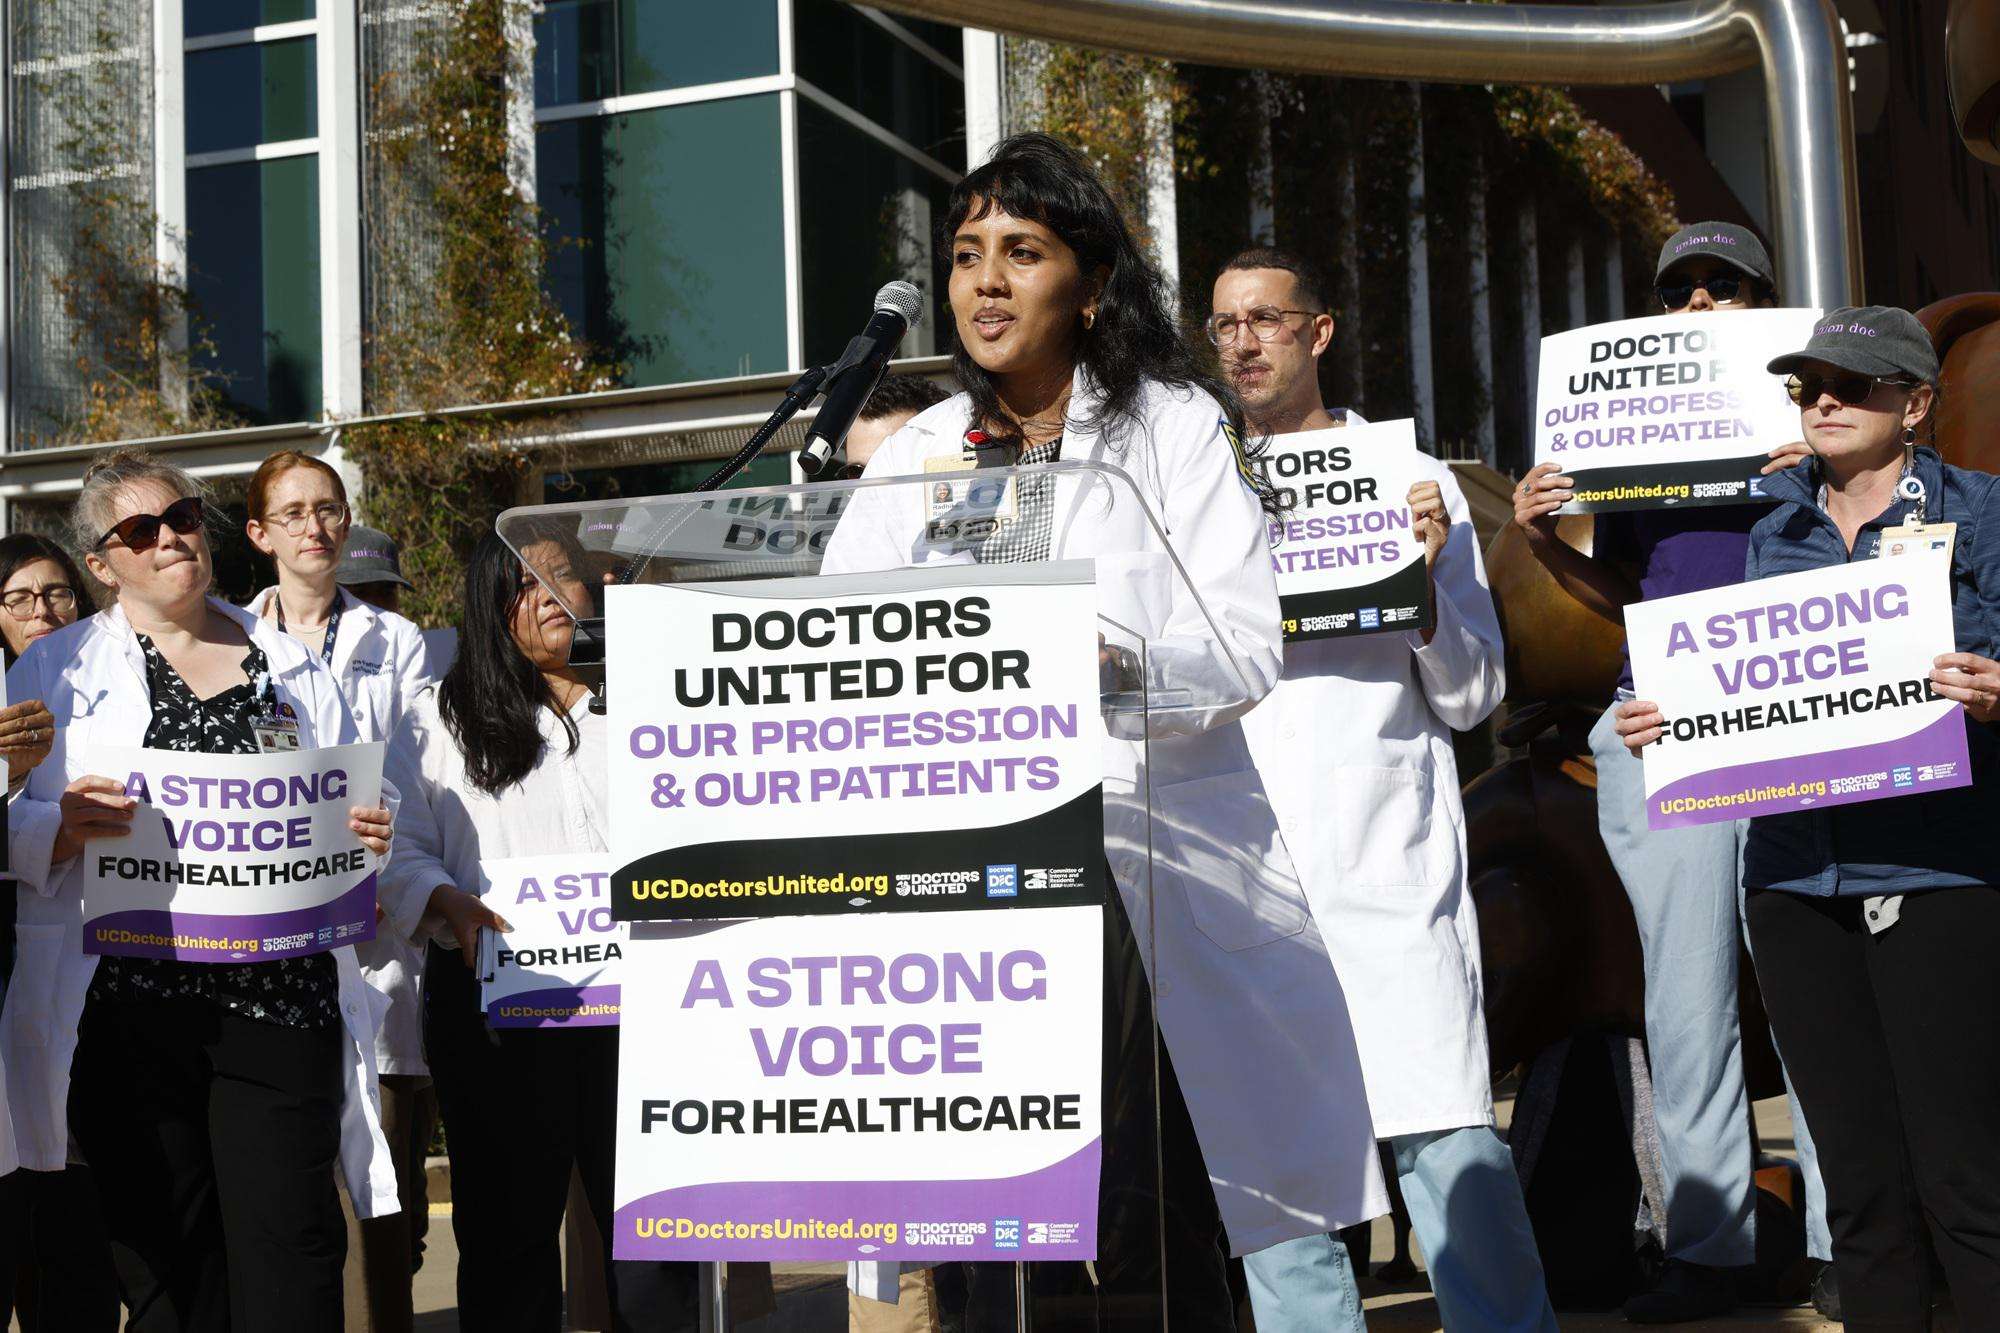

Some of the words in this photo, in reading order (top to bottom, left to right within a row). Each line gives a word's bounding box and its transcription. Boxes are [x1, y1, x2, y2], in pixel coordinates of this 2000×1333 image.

[1590, 330, 1710, 363] DOCTO
[1849, 322, 1877, 338] doc
[1569, 361, 1701, 395] UNITED
[1545, 402, 1600, 428] OUR
[1608, 390, 1743, 419] PROFESS
[1551, 433, 1568, 452] &
[1573, 426, 1635, 449] OUR
[1641, 418, 1755, 444] PATIEN
[1305, 477, 1378, 508] FOR
[712, 596, 991, 653] DOCTORS
[1666, 621, 1700, 658] A
[1705, 583, 1909, 650] STRONG
[674, 657, 904, 708] UNITED
[916, 649, 1031, 695] FOR
[1712, 637, 1869, 695] VOICE
[630, 722, 738, 759] OUR
[752, 703, 1078, 755] PROFESSION
[124, 772, 152, 803] A
[160, 769, 347, 809] STRONG
[651, 772, 685, 809] &
[695, 770, 801, 807] OUR
[811, 755, 1060, 802] PATIENTS
[1840, 772, 1888, 785] DOCTORS
[1841, 781, 1879, 793] UNITED
[1660, 779, 1827, 815] UCDoctorsUnited.org
[162, 816, 312, 851] VOICE
[99, 856, 160, 882] FOR
[164, 848, 365, 886] HEALTHCARE
[911, 871, 980, 884] DOCTORS
[516, 877, 547, 904] A
[554, 872, 609, 900] ST
[631, 872, 888, 900] UCDoctorsUnited.org
[911, 883, 967, 896] UNITED
[557, 907, 618, 935] VO
[96, 929, 258, 952] UCDoctorsUnited.org
[273, 932, 314, 944] DOCTORS
[273, 940, 307, 951] UNITED
[498, 948, 558, 967] FOR
[562, 943, 622, 965] HEA
[680, 959, 734, 1009] A
[746, 949, 1047, 1008] STRONG
[749, 1022, 983, 1077] VOICE
[641, 1099, 746, 1134] FOR
[752, 1094, 1081, 1134] HEALTHCARE
[636, 1218, 898, 1245] UCDoctorsUnited.org
[920, 1223, 987, 1234] DOCTORS
[920, 1234, 975, 1245] UNITED
